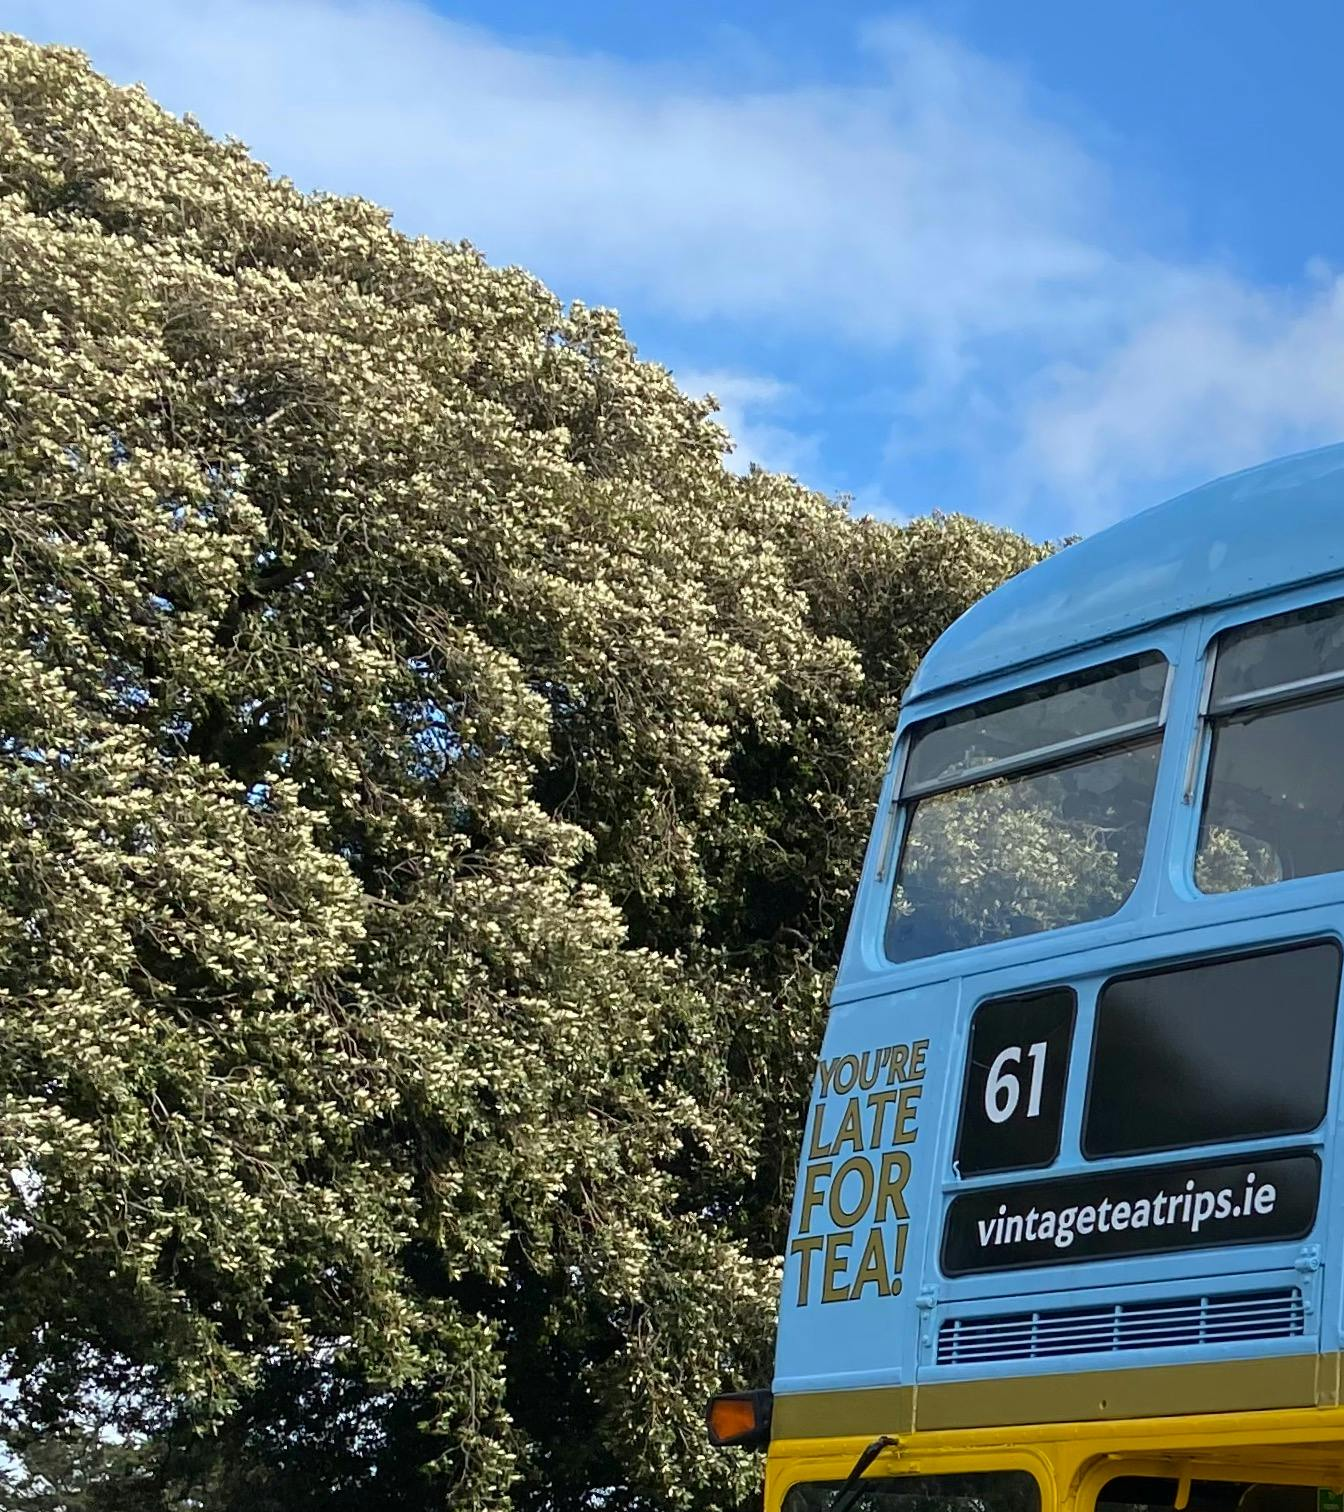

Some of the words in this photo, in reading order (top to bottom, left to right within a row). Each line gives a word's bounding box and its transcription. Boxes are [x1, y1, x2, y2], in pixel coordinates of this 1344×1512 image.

[817, 1038, 930, 1099] YOU'RE
[984, 1042, 1049, 1124] 61
[809, 1084, 923, 1160] LATE
[799, 1151, 912, 1234] FOR
[977, 1174, 1277, 1249] vintageteatrips.ie
[791, 1223, 908, 1307] TEA!
